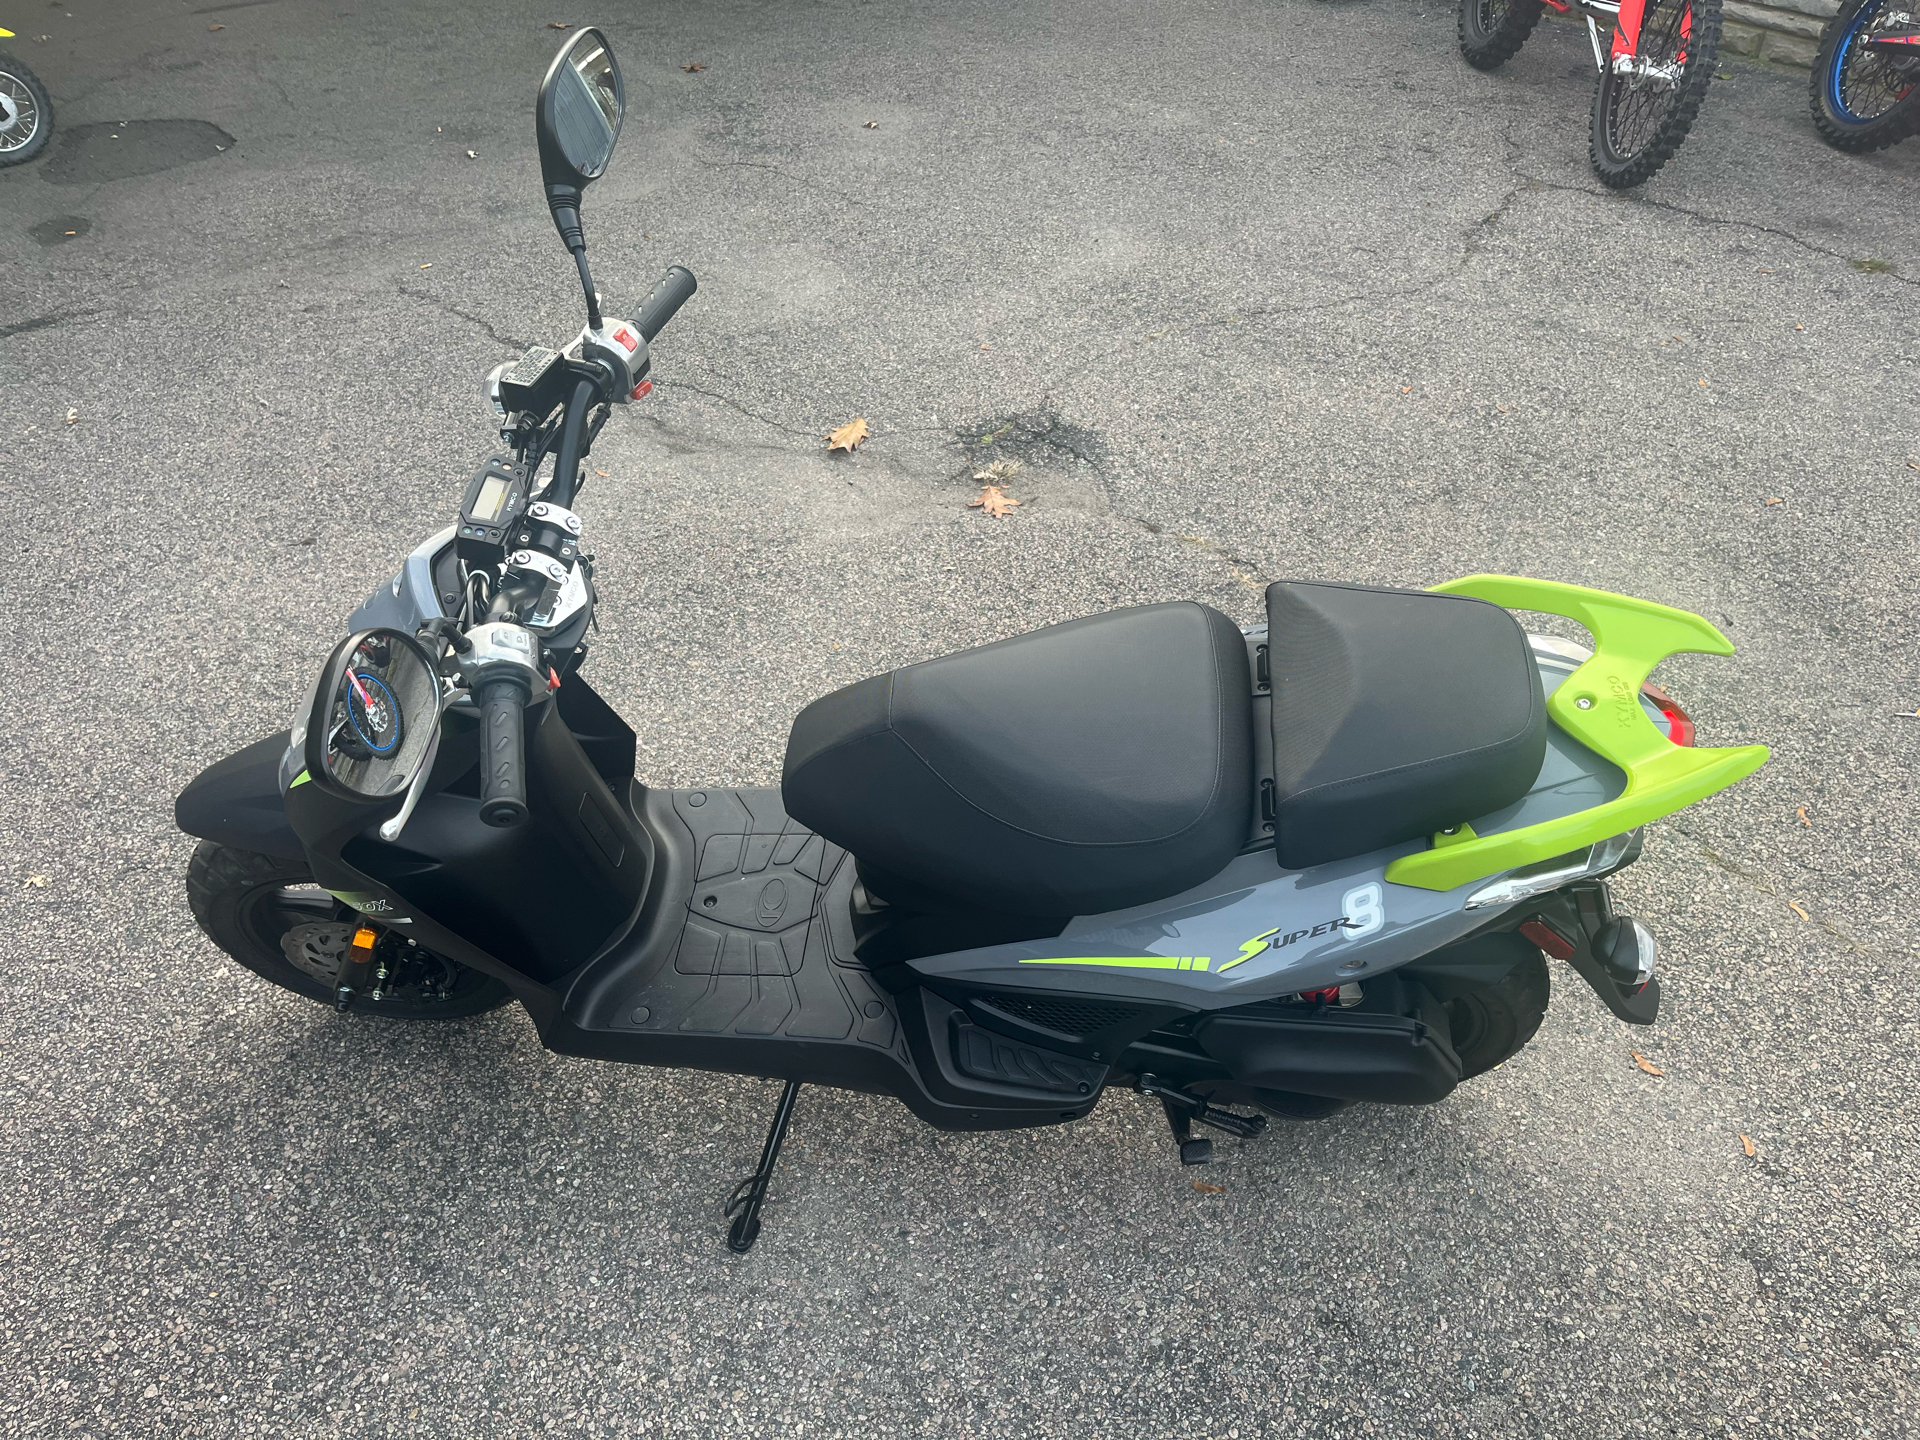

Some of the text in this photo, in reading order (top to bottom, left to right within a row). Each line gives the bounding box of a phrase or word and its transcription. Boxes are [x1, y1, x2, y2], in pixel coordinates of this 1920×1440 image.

[506, 493, 517, 512] KYMCO
[565, 581, 579, 608] KYMCO
[1607, 676, 1631, 728] KYMCO
[1217, 881, 1385, 973] SUPER 8
